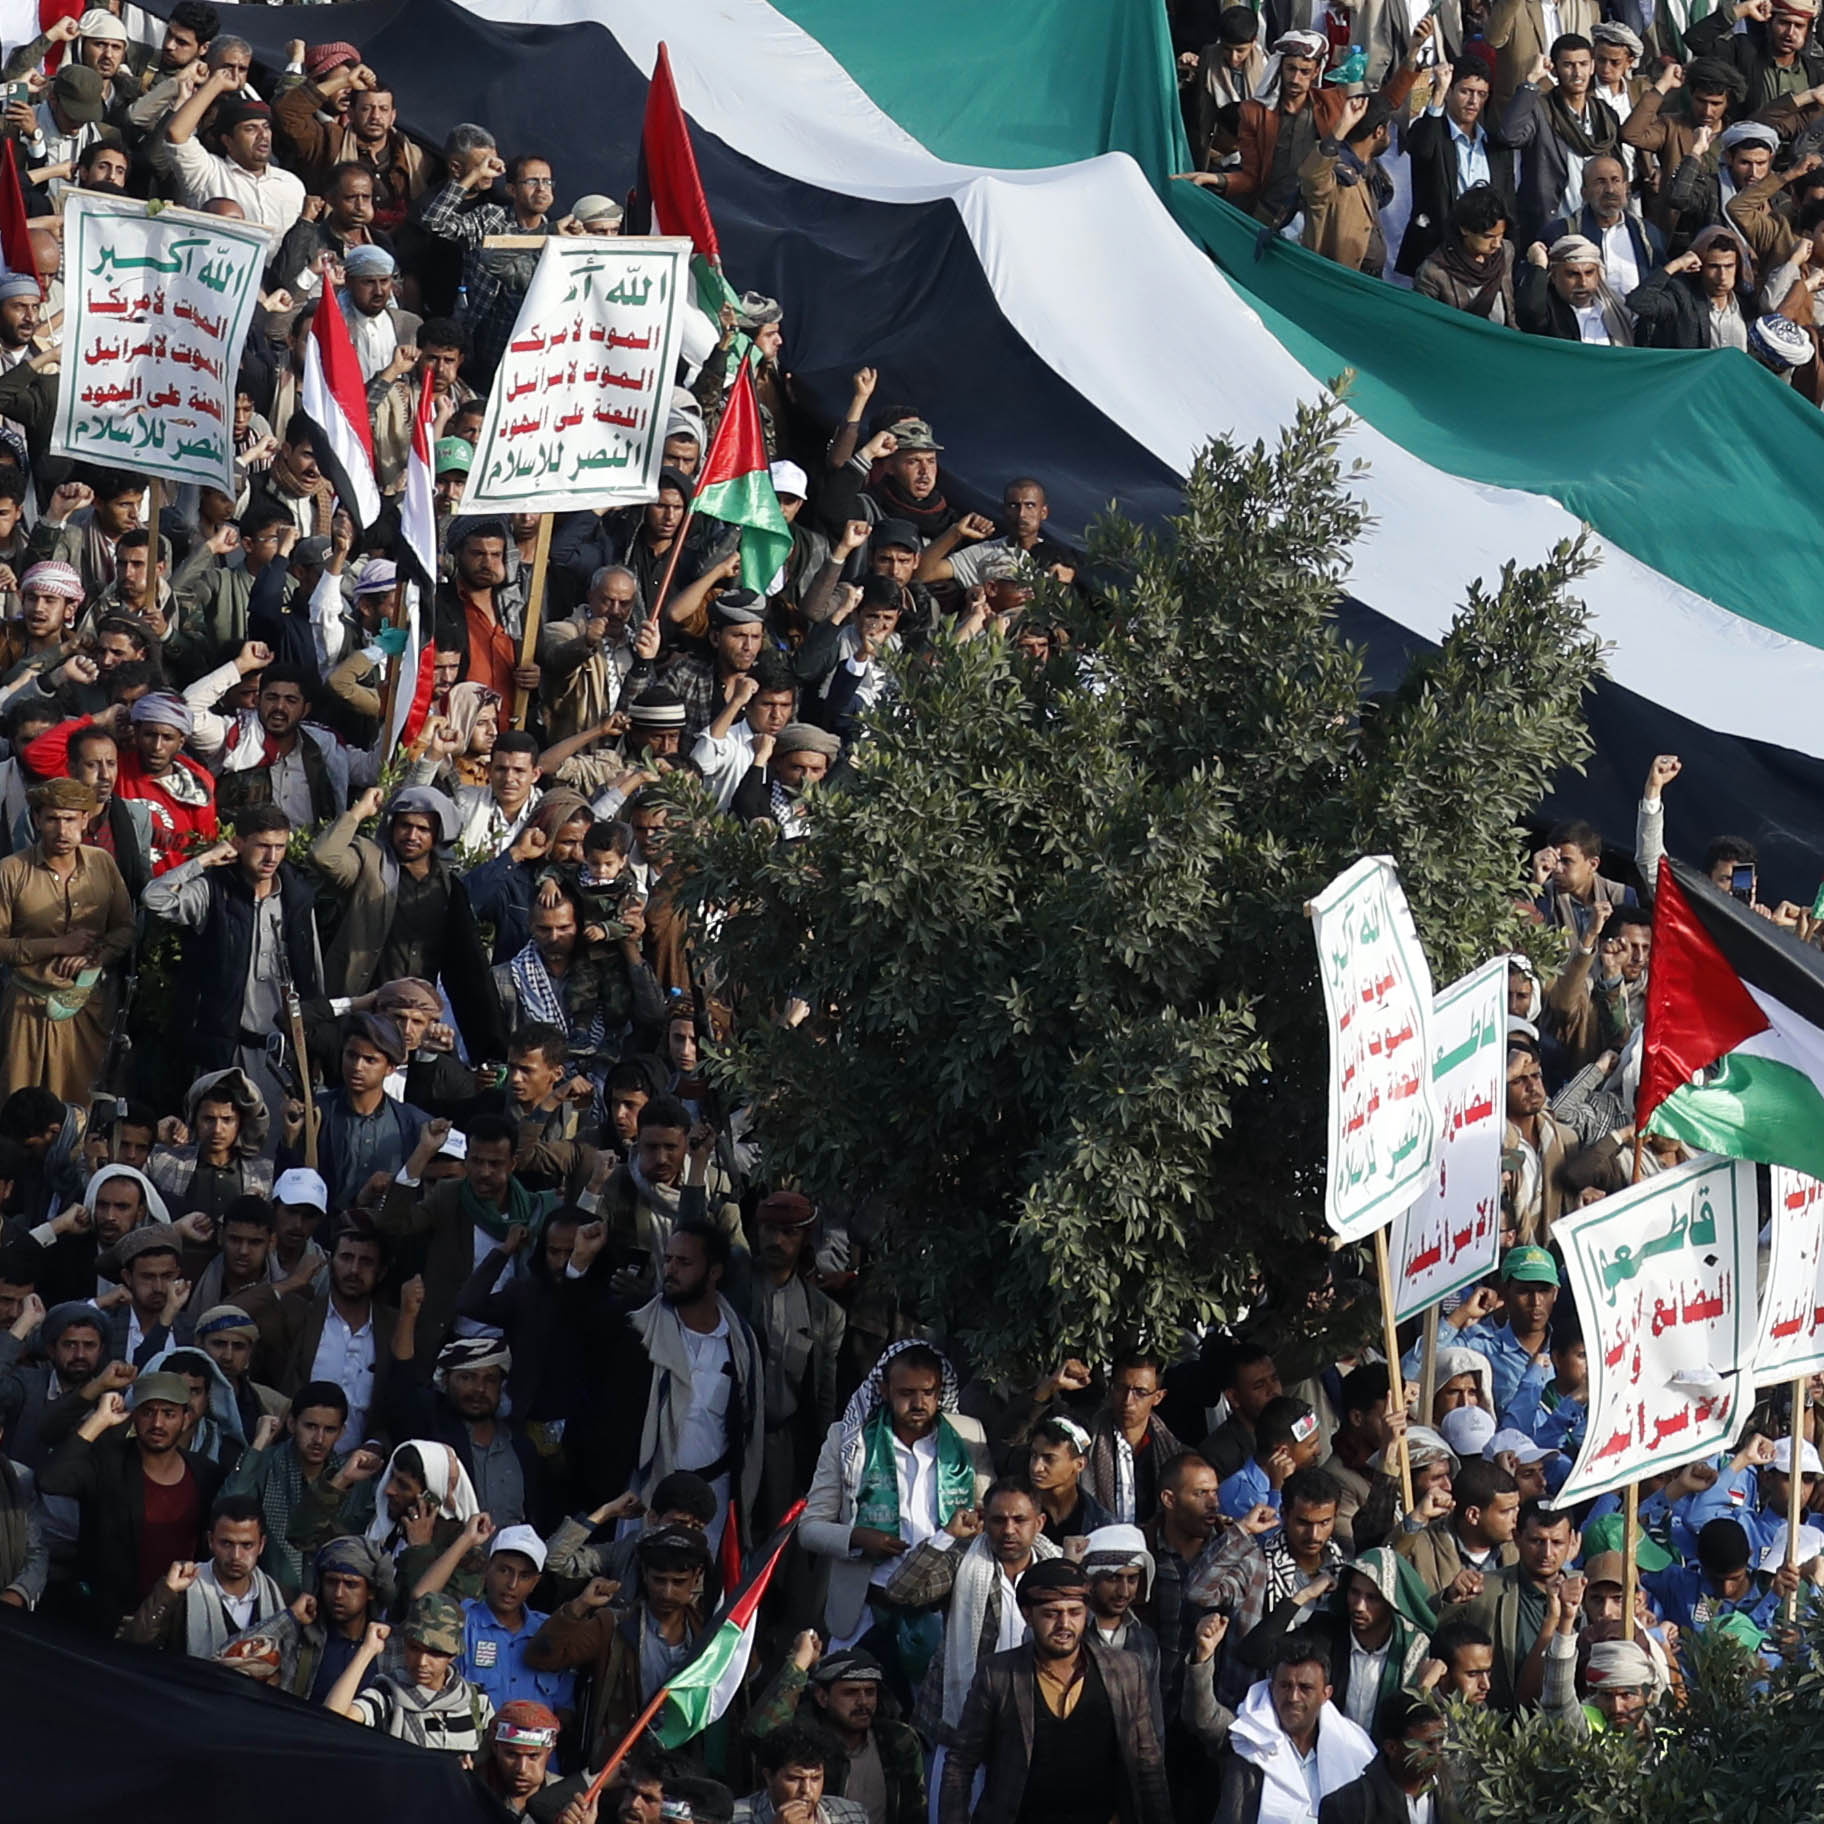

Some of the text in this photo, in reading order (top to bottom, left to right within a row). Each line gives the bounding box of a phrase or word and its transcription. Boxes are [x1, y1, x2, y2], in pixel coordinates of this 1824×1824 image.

[196, 248, 248, 301] الله
[606, 265, 667, 305] الله
[172, 301, 229, 343] الموت
[590, 327, 661, 351] الموت
[170, 342, 223, 381] الموت
[582, 367, 654, 392] الموت
[167, 418, 225, 466] النصر
[568, 431, 641, 481] النصر
